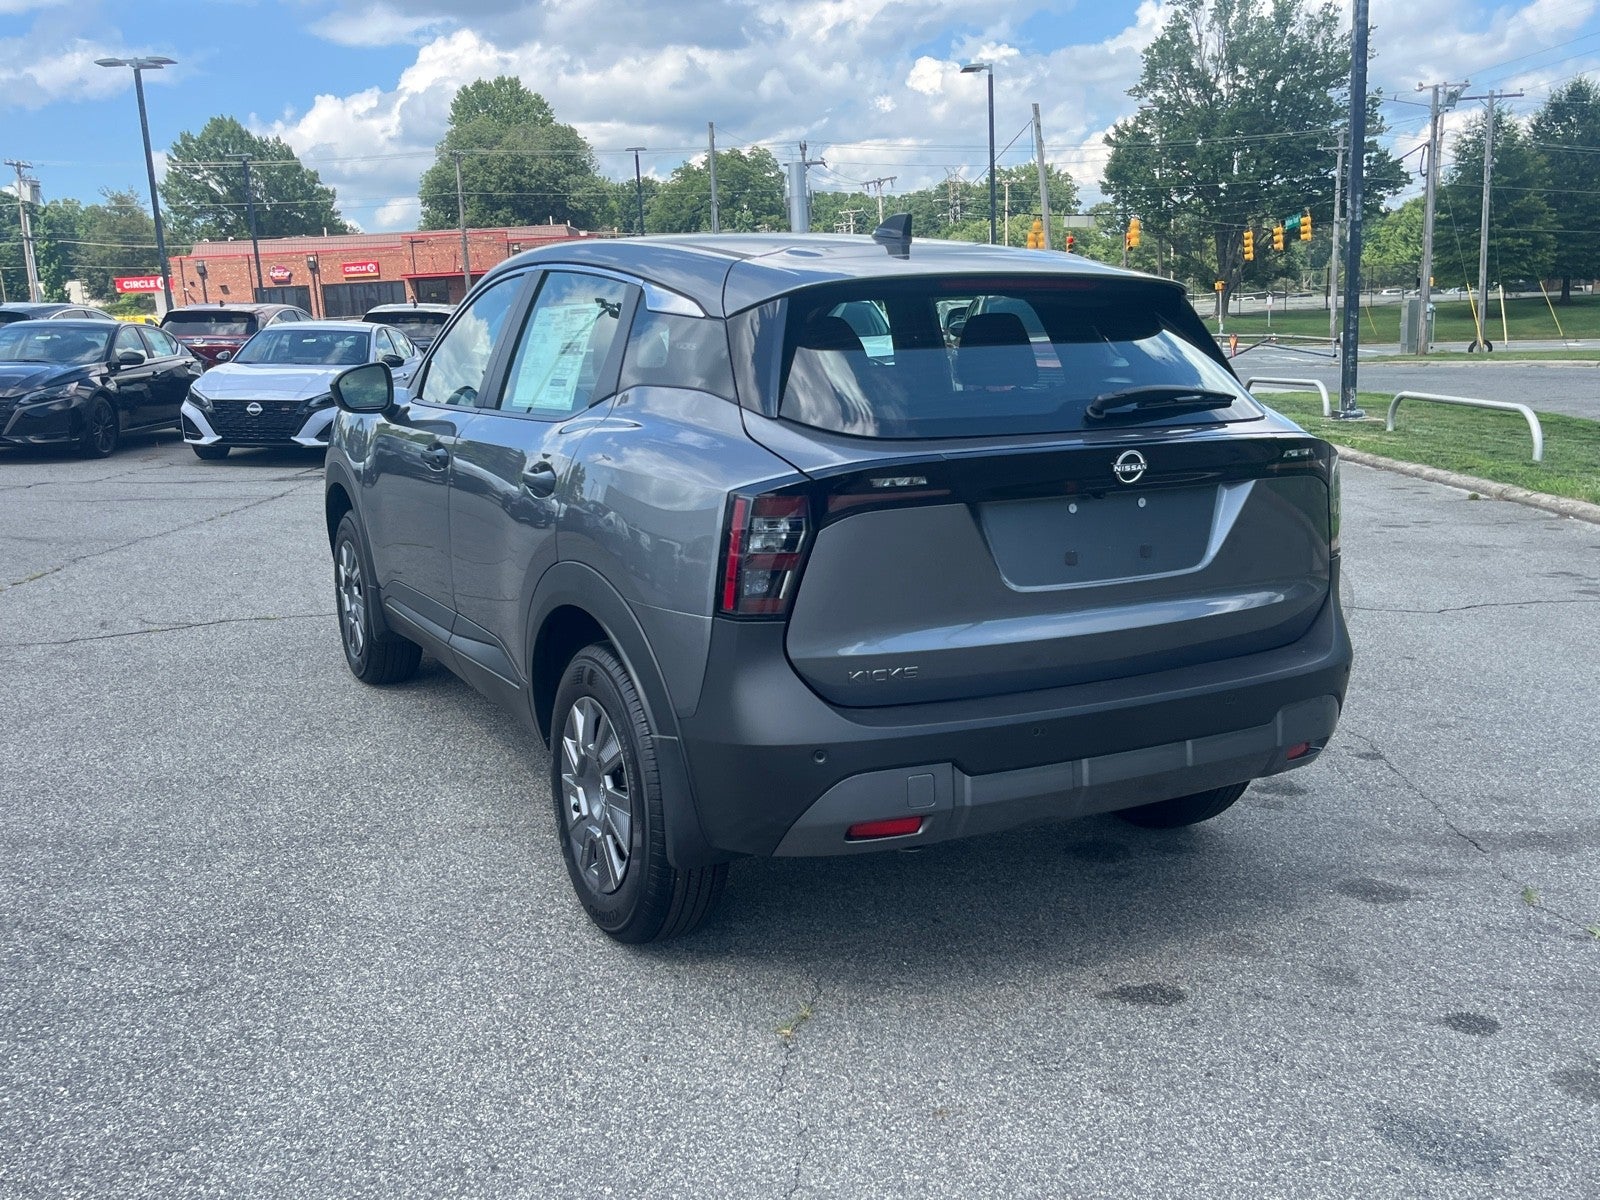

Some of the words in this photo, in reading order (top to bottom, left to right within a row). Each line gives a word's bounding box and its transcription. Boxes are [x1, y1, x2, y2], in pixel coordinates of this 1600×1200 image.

[345, 265, 367, 273] CIRCLE
[123, 279, 156, 289] CIRCLE
[1113, 464, 1147, 472] NISSAN
[848, 666, 919, 683] KICKS
